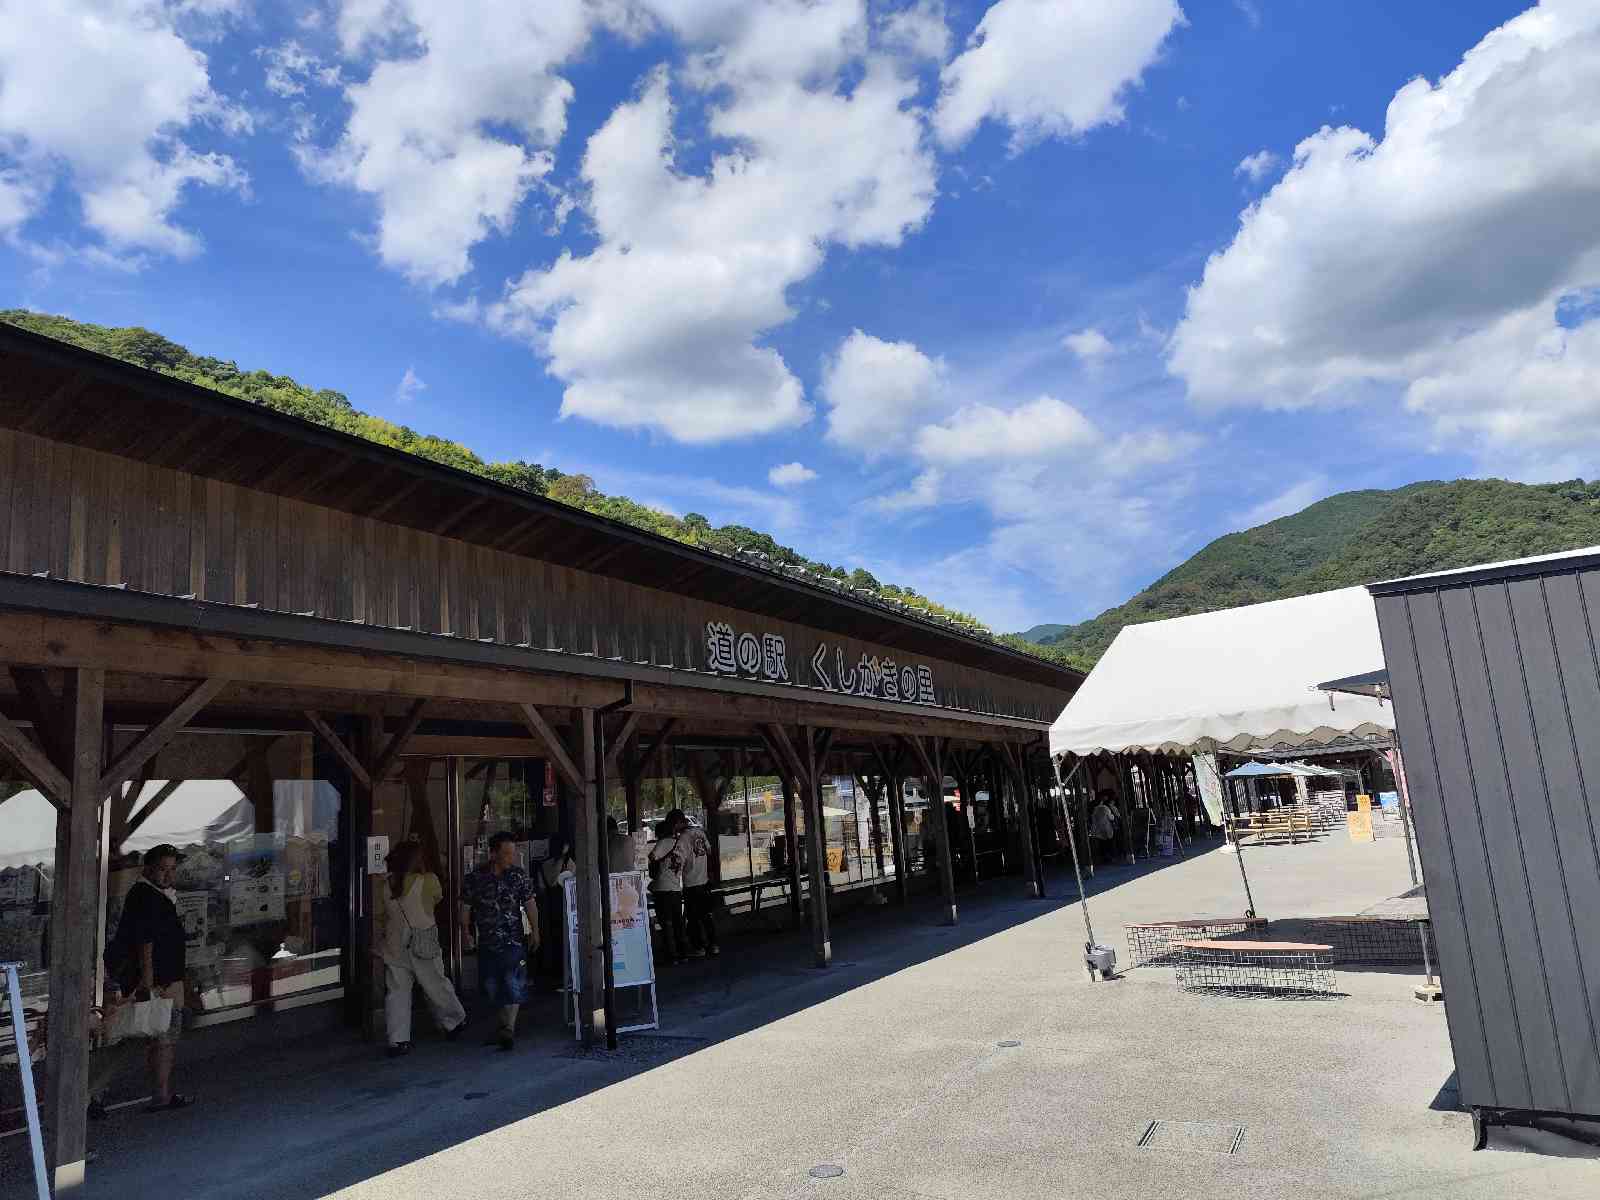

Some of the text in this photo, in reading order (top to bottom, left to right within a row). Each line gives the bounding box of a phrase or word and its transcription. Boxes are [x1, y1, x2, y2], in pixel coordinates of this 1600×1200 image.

[705, 621, 936, 705] 道の駅 くしがきの里
